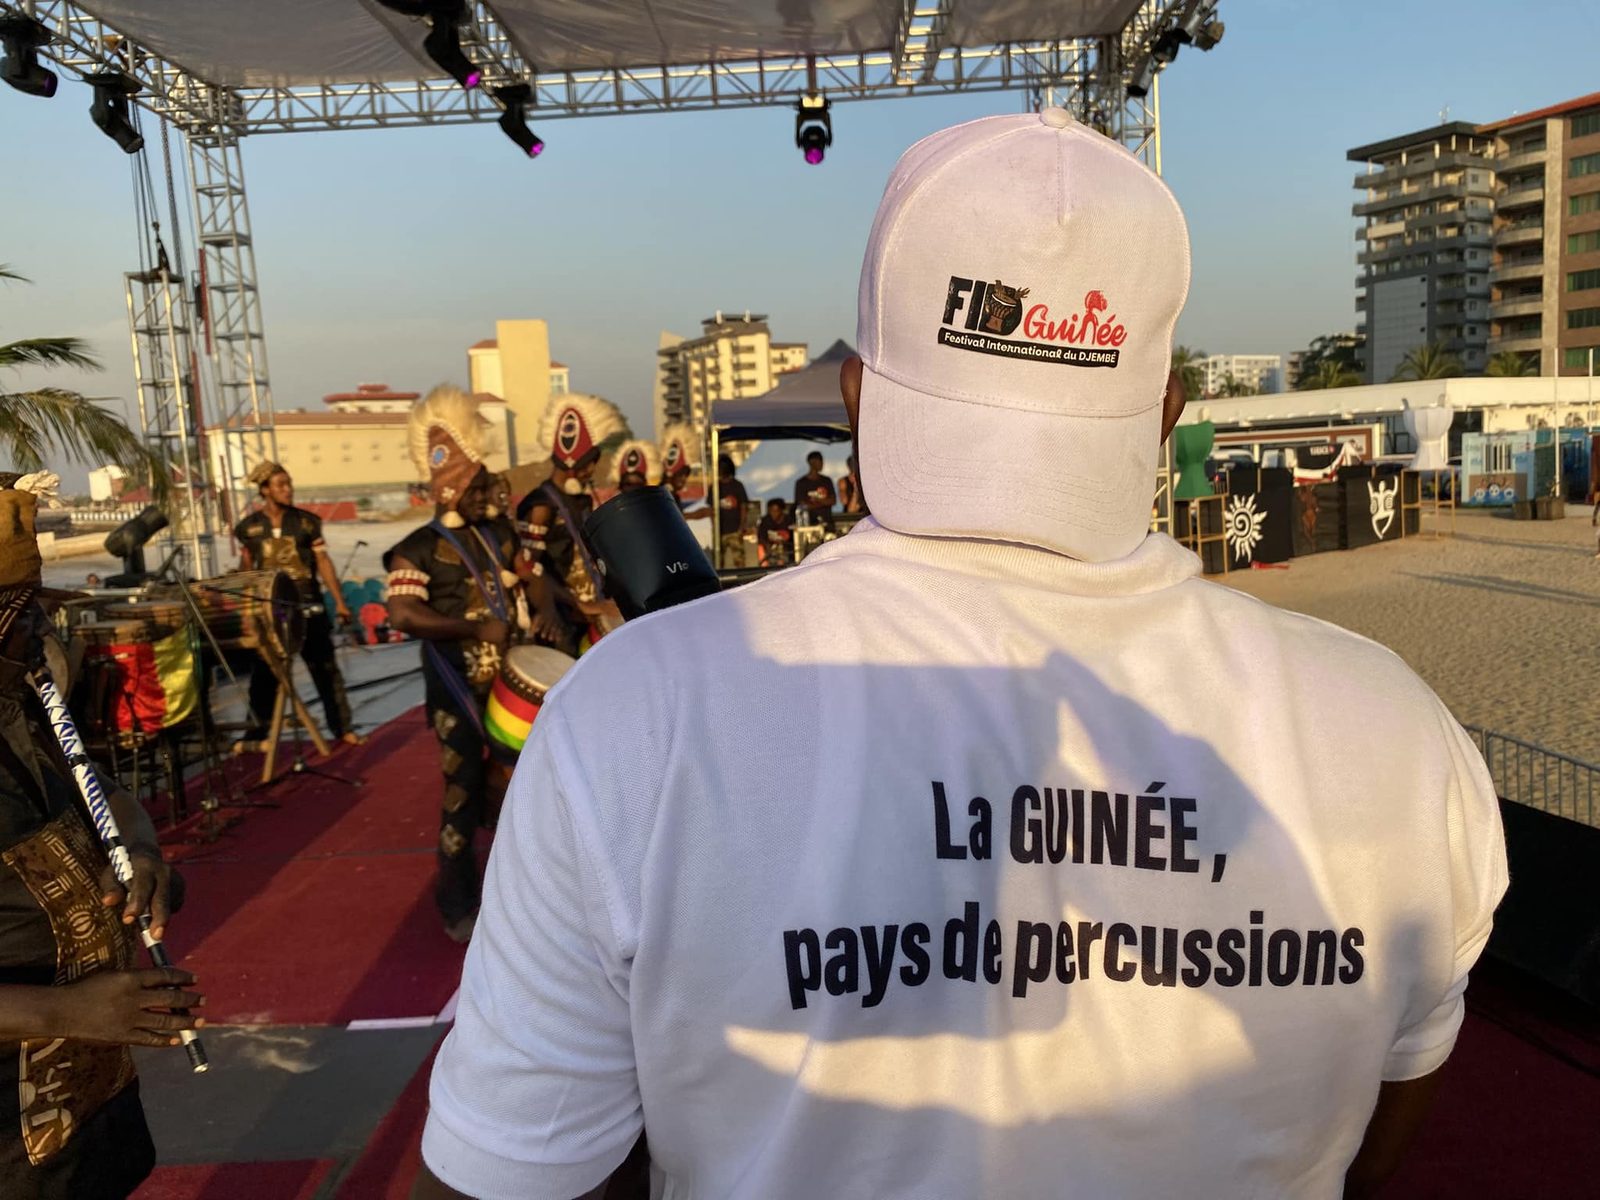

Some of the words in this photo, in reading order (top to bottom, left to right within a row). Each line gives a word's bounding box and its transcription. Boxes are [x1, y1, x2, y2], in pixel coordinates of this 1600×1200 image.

[942, 275, 1023, 336] FID
[1023, 294, 1128, 347] Guinée
[944, 332, 985, 349] Festival
[986, 340, 1062, 359] International
[1063, 350, 1077, 360] du
[1078, 351, 1117, 363] DJEMBÉ
[931, 781, 992, 861] La
[783, 922, 931, 1010] pays
[942, 901, 1002, 984] de
[1012, 911, 1365, 998] percussions
